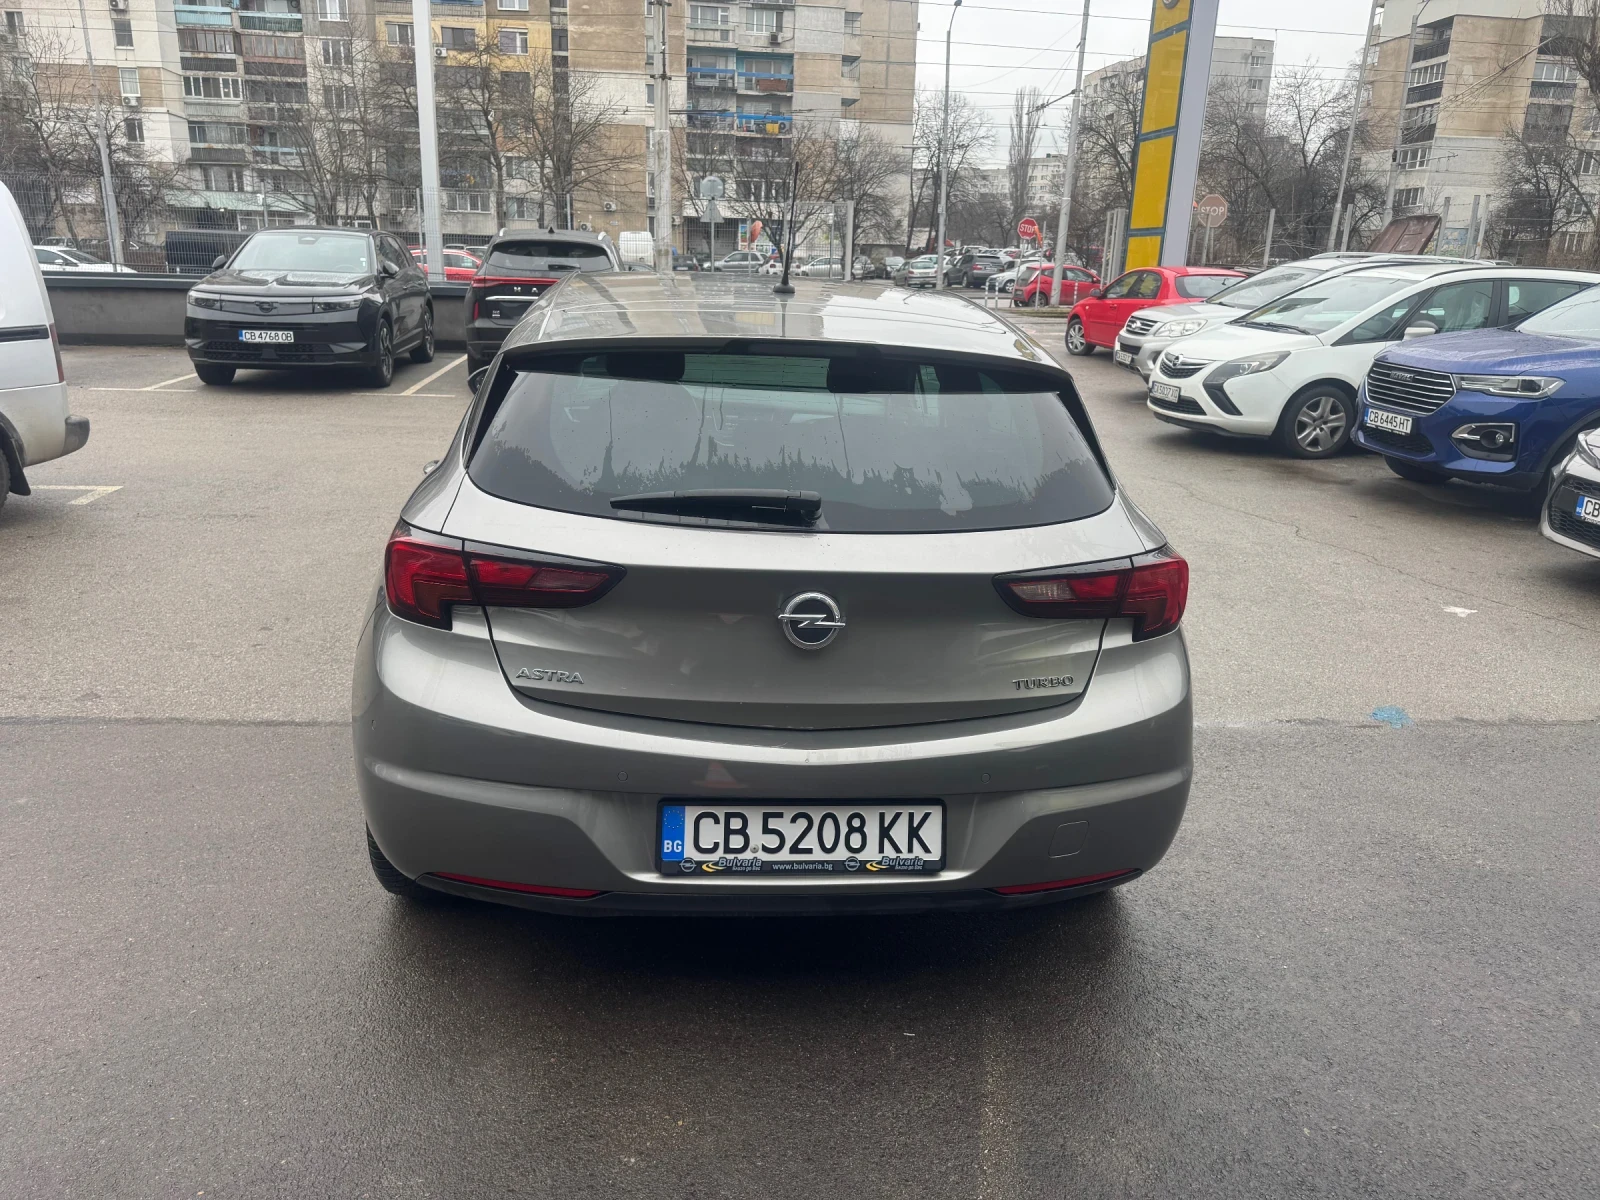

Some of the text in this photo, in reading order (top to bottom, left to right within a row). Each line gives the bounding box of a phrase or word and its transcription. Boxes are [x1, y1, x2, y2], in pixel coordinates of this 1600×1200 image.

[1201, 206, 1225, 216] STOP
[244, 331, 256, 341] CB
[258, 331, 280, 341] 4768
[1368, 410, 1379, 423] CB
[1379, 413, 1399, 428] 6445
[1398, 417, 1411, 431] HT
[1584, 500, 1600, 518] CB
[515, 667, 584, 685] ASTRA
[1012, 674, 1074, 691] TURBO
[692, 811, 932, 855] CB 5208 KK
[663, 840, 683, 853] BG
[718, 856, 763, 867] Bulvaria
[772, 862, 834, 871] www.bulvaria.bg
[881, 856, 925, 866] Bulvaria
